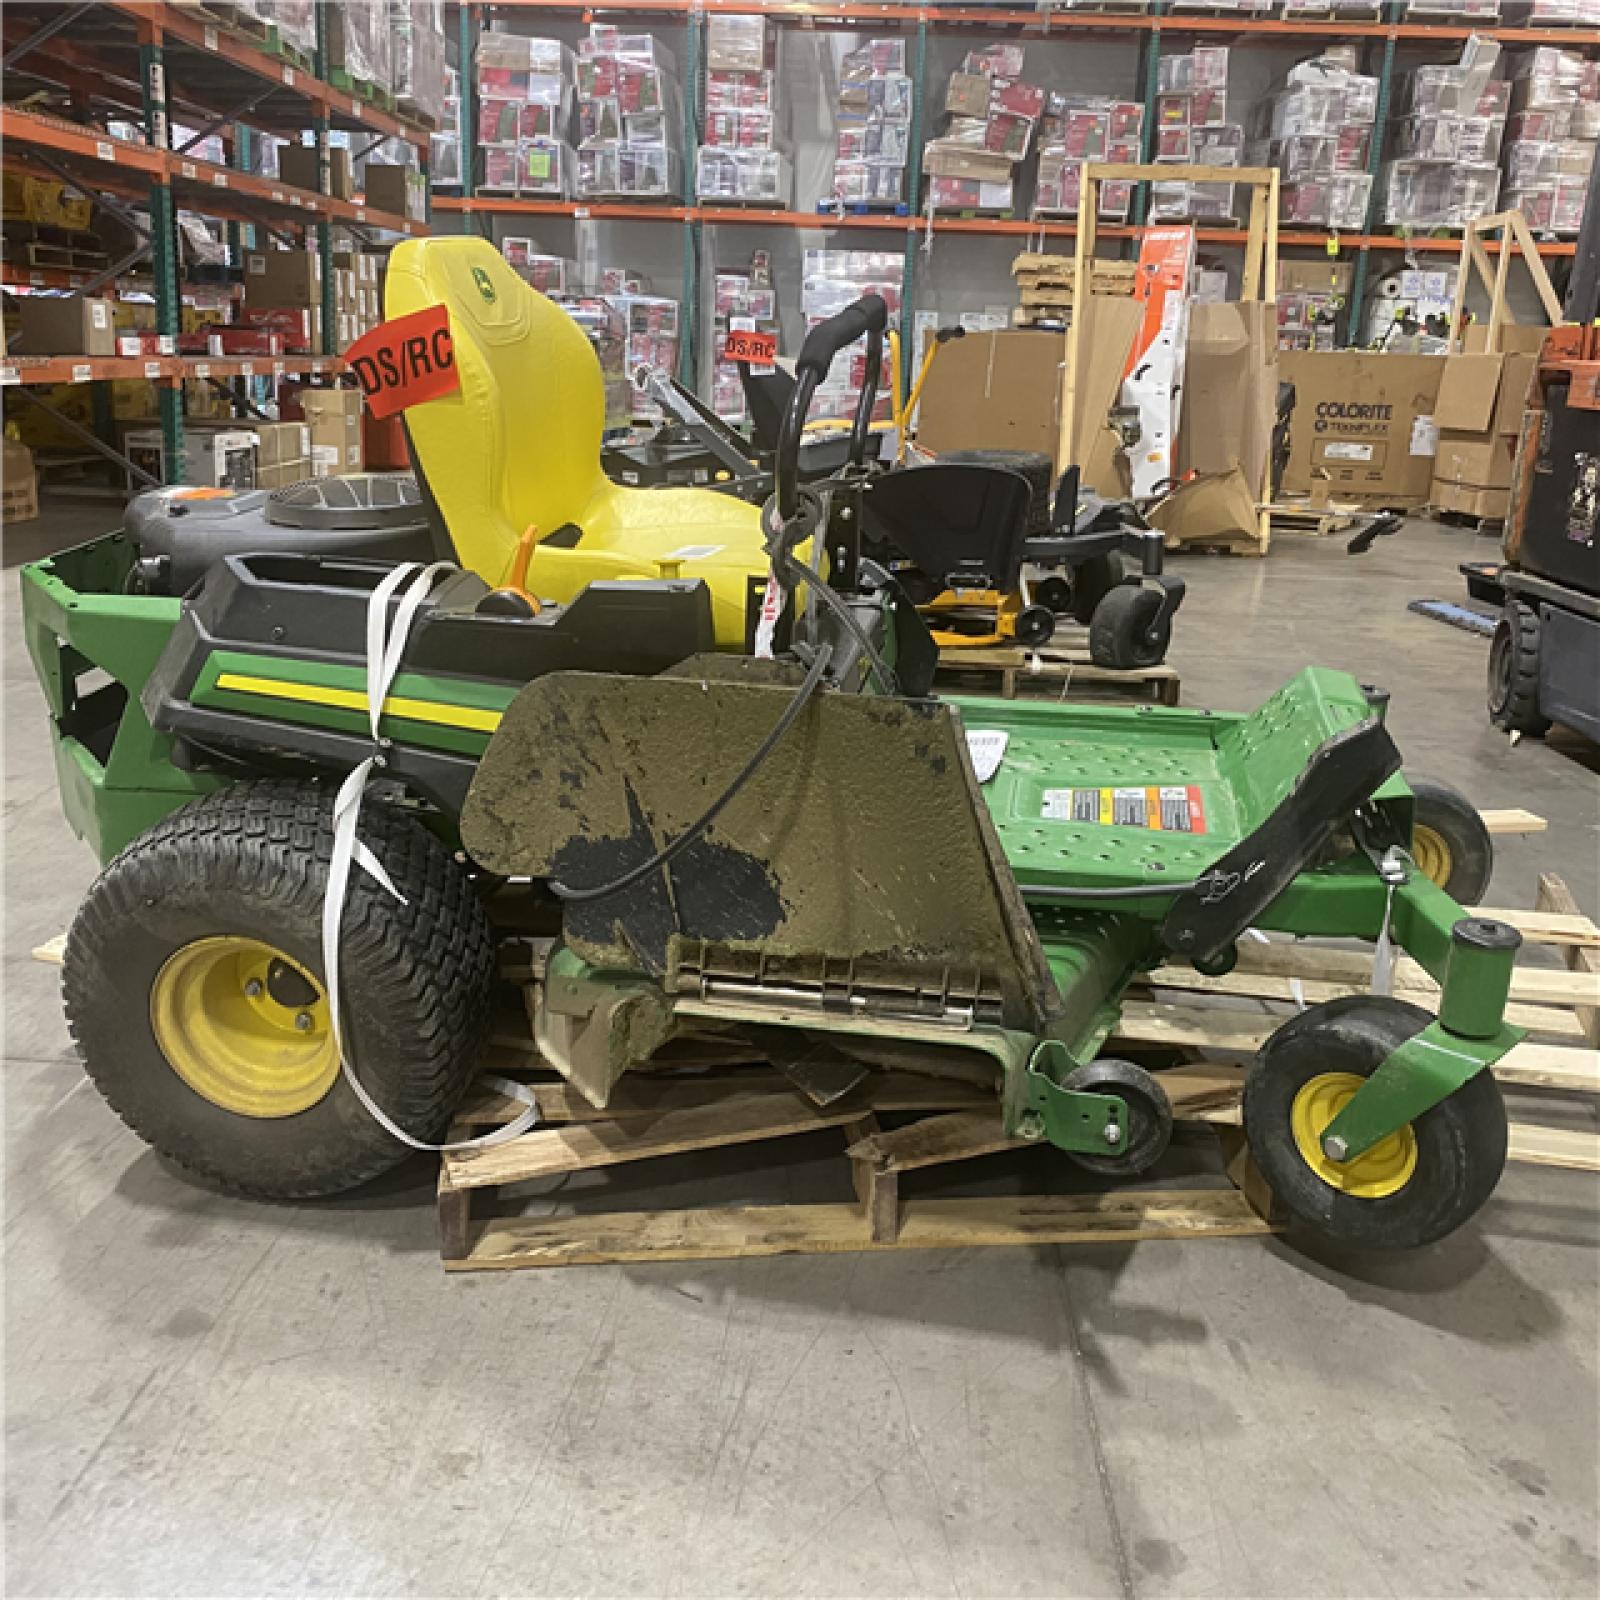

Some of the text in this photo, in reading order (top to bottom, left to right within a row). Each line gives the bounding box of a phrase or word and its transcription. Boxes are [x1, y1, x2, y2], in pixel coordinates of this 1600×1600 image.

[726, 337, 775, 358] DS/RC
[351, 328, 453, 395] DS/RC
[1315, 402, 1392, 420] COLORITE
